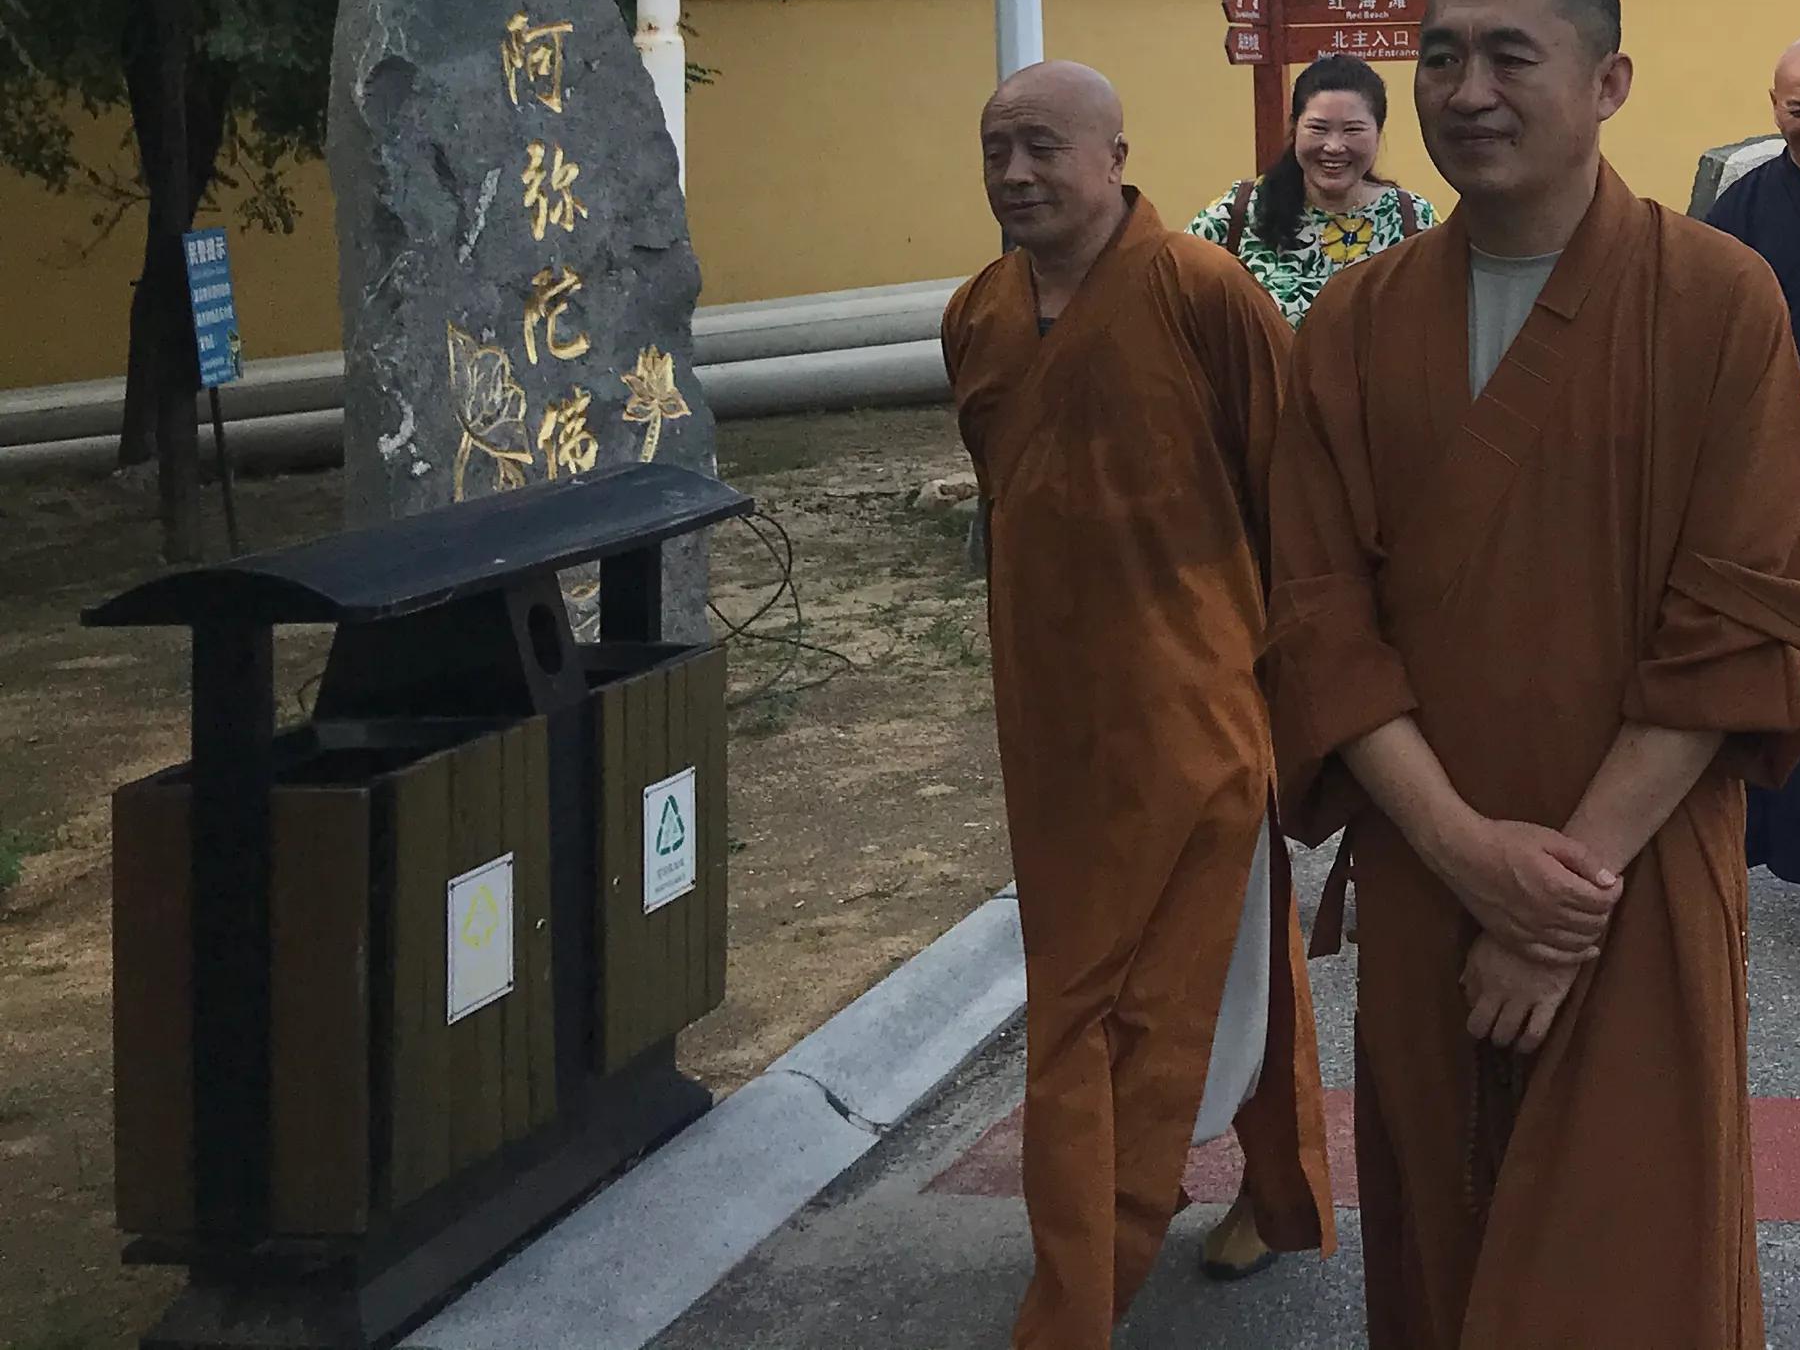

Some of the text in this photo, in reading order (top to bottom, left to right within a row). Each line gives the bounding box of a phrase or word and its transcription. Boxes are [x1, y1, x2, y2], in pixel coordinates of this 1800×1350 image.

[1346, 11, 1389, 19] Red Beach
[1331, 30, 1409, 48] 北主入口
